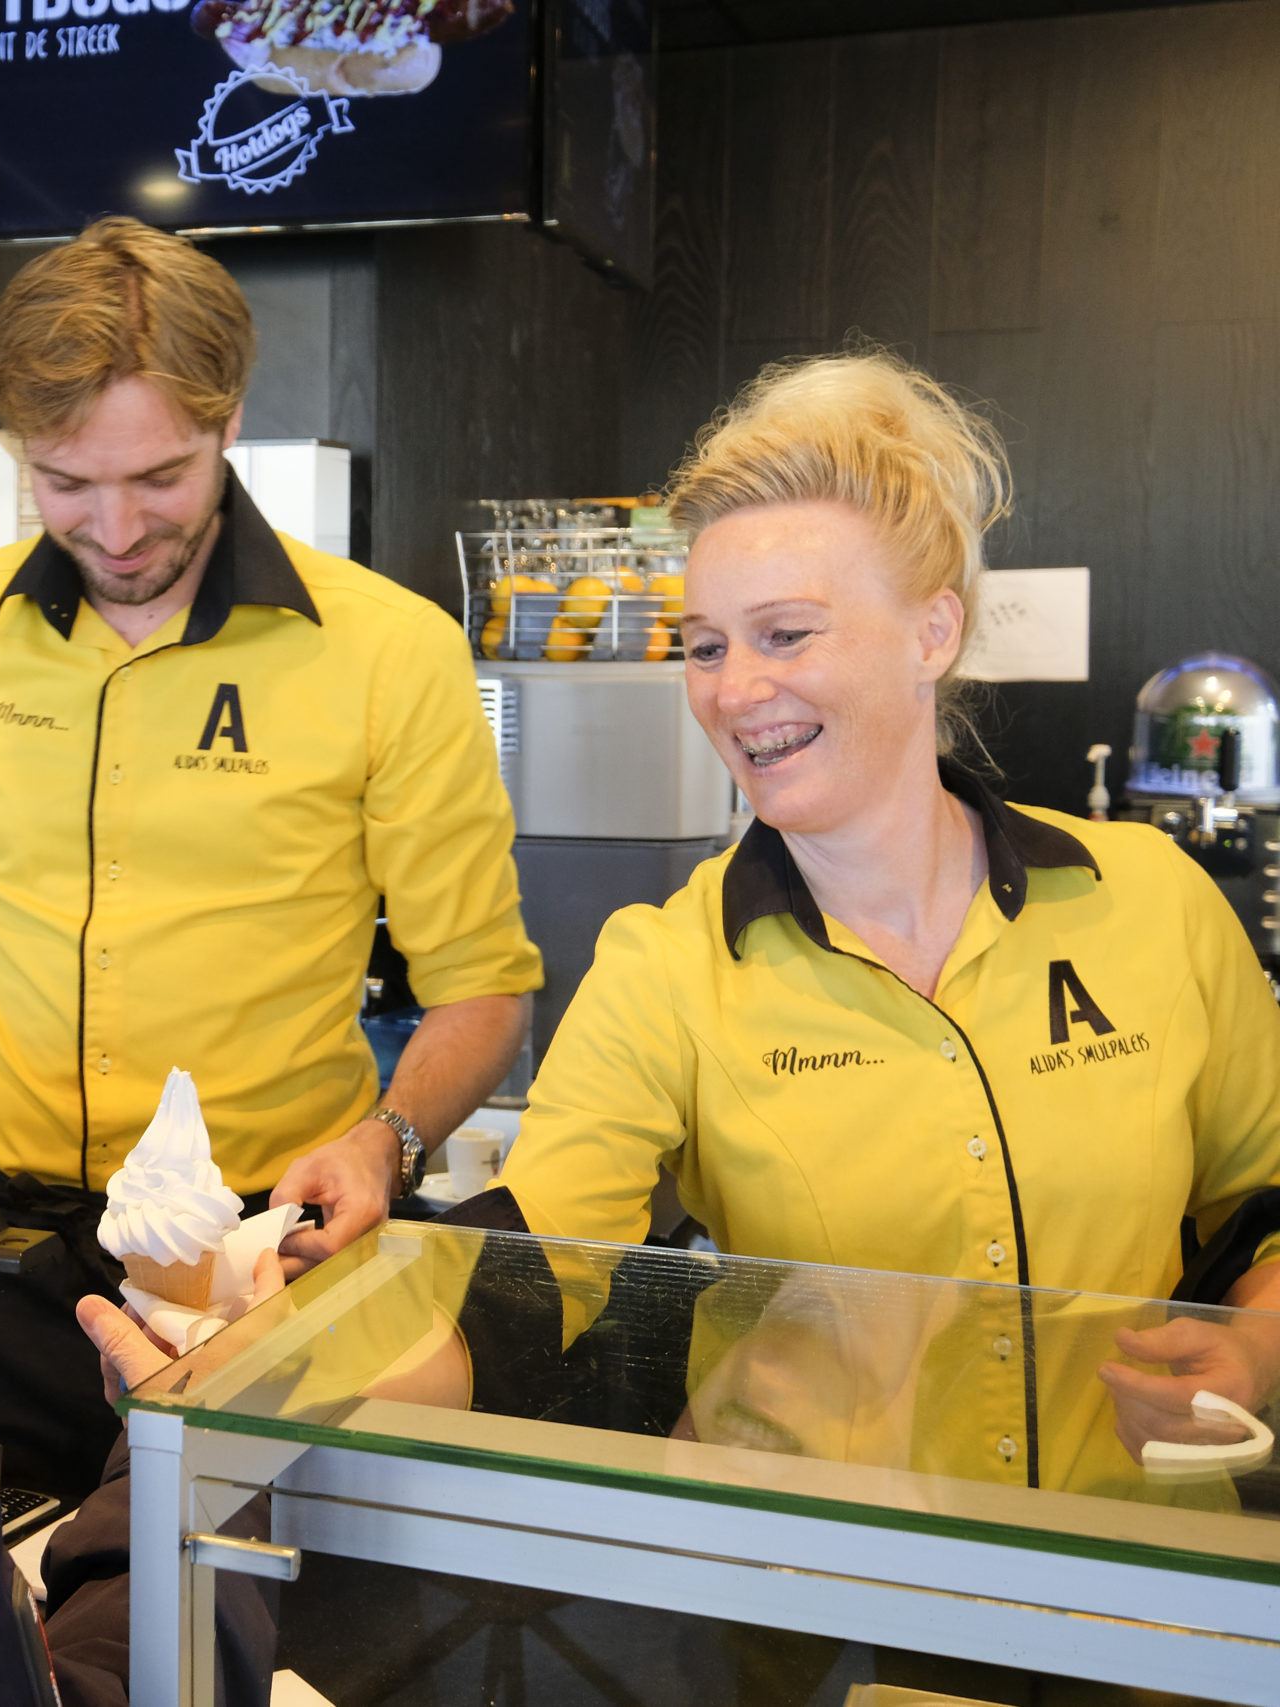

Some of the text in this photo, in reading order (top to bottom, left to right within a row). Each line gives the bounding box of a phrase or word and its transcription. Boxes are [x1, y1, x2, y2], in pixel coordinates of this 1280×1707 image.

[25, 28, 48, 60] DE
[56, 23, 120, 57] STREEK
[214, 106, 311, 172] Hotdogs
[197, 683, 248, 753] A
[1049, 959, 1117, 1045] A
[1030, 1032, 1150, 1075] ALIDA'S SMULPALEIS
